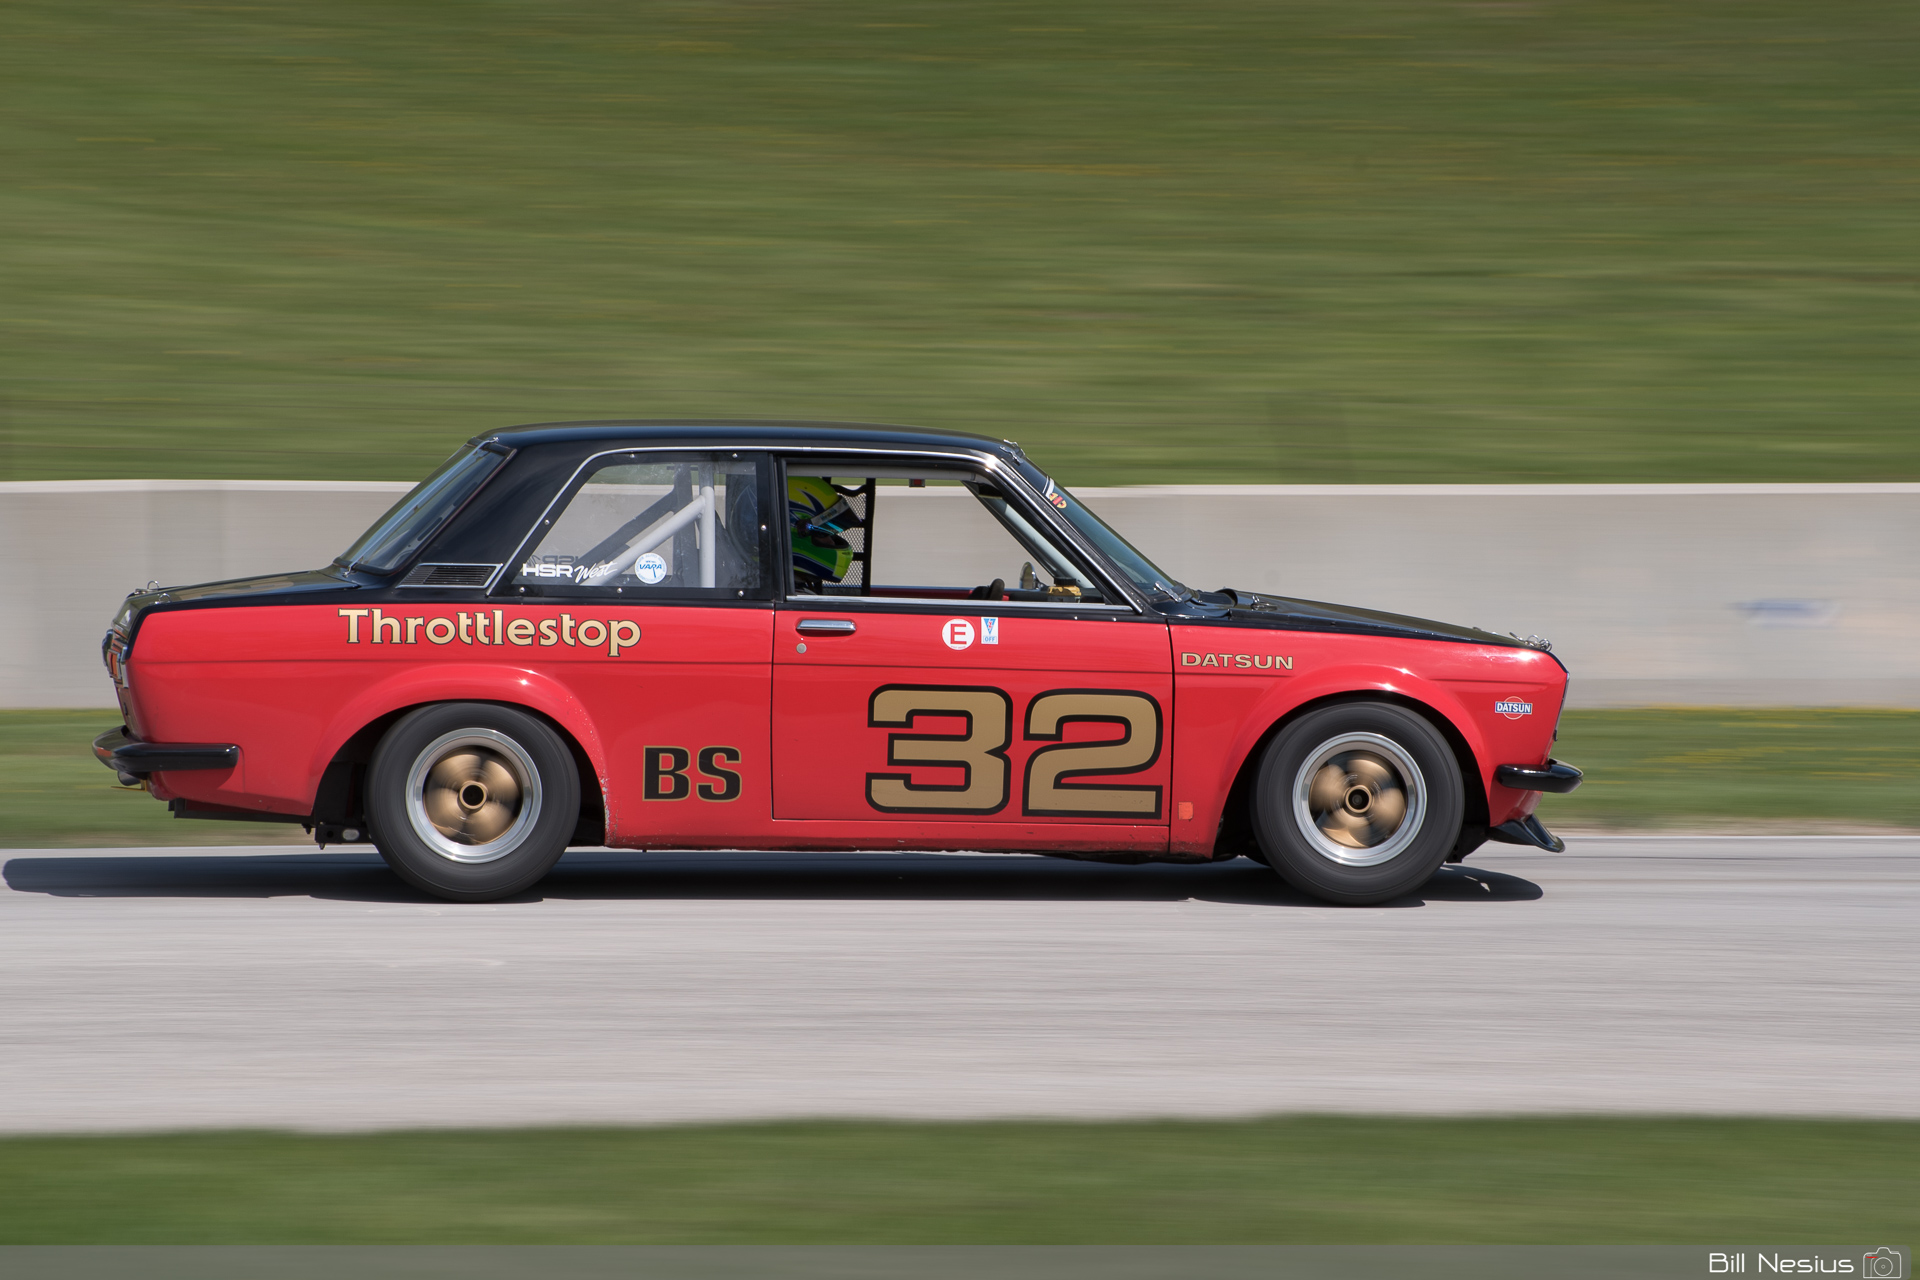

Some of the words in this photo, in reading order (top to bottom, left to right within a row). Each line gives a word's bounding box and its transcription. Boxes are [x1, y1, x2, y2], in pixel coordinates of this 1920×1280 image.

[522, 563, 573, 577] HSR
[574, 561, 618, 583] West
[338, 608, 642, 657] Throttlestop
[950, 623, 967, 645] E
[1181, 652, 1293, 670] DATSUN
[1497, 702, 1531, 713] DATSUN
[865, 684, 1164, 817] 32
[642, 745, 742, 803] BS
